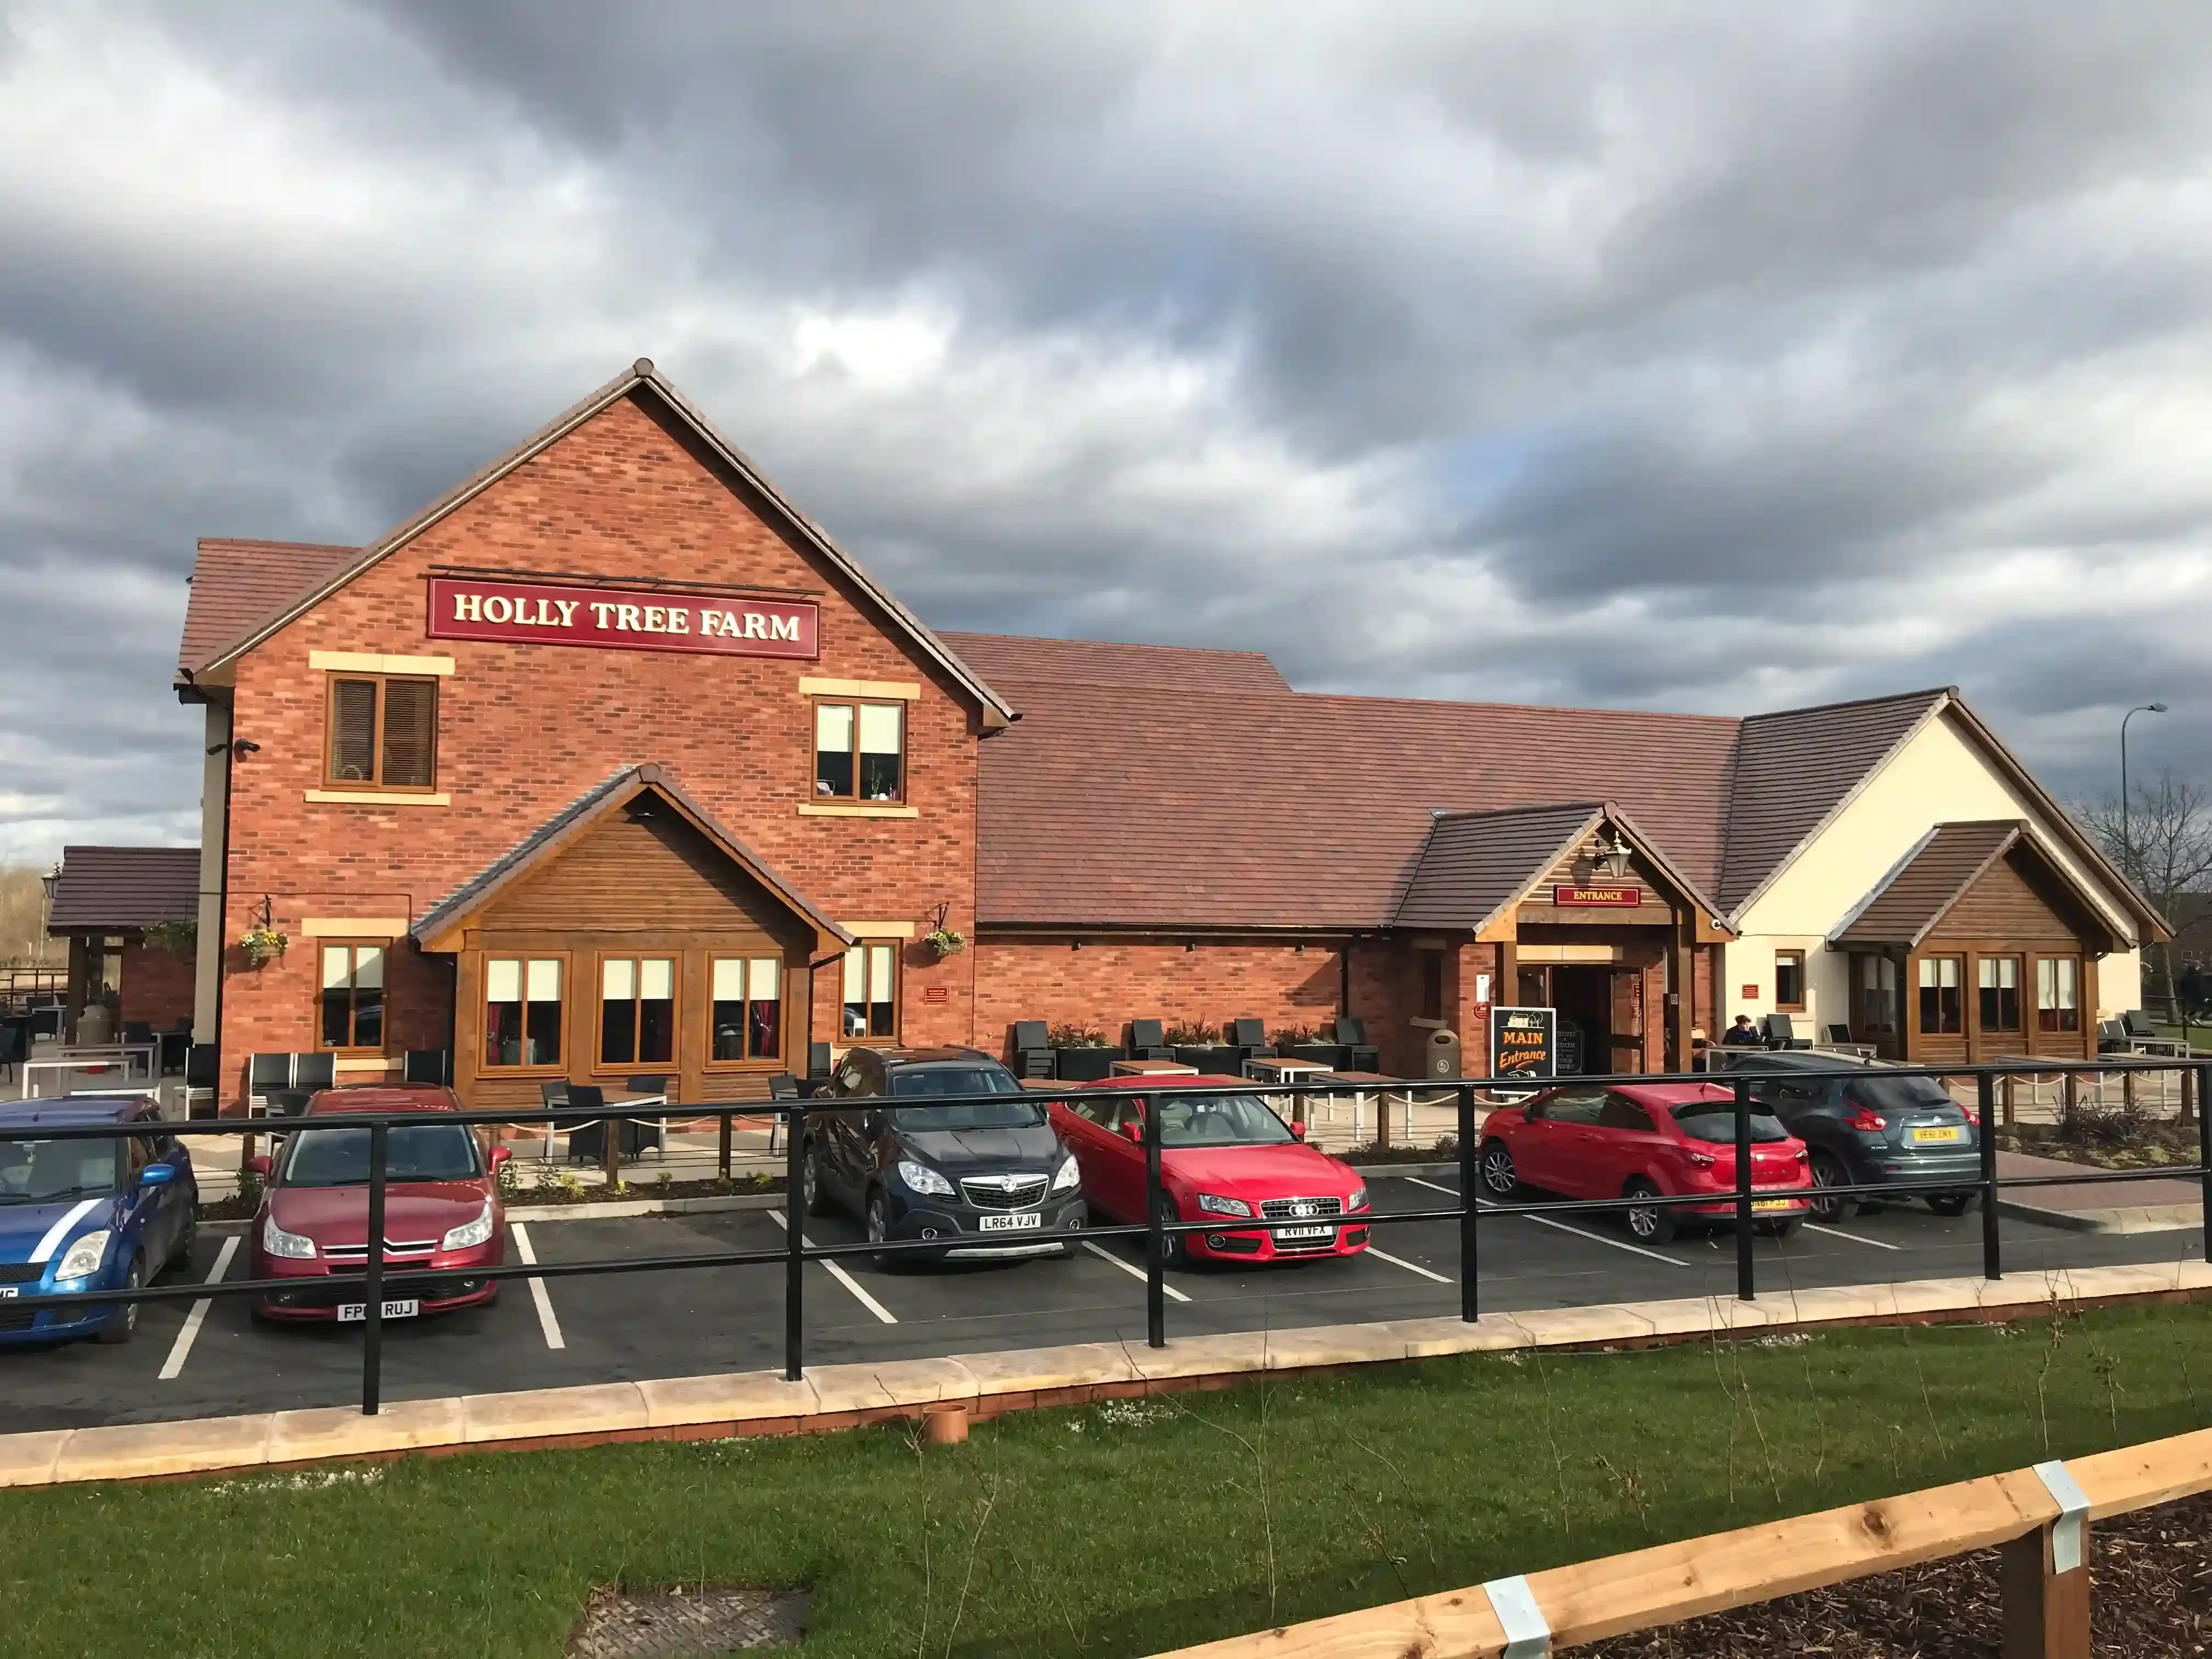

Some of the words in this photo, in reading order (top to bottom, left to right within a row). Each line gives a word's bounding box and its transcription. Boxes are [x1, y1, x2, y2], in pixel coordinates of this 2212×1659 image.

[453, 594, 580, 627] HOLLY
[589, 602, 690, 635] TREE
[699, 610, 800, 642] FARM
[1573, 891, 1623, 900] ENTRANCE
[1503, 1031, 1543, 1045] MAIN
[1499, 1050, 1547, 1070] Entrance
[985, 1217, 1014, 1229] LR64
[1017, 1215, 1037, 1227] VJV
[385, 1302, 413, 1316] RUJ
